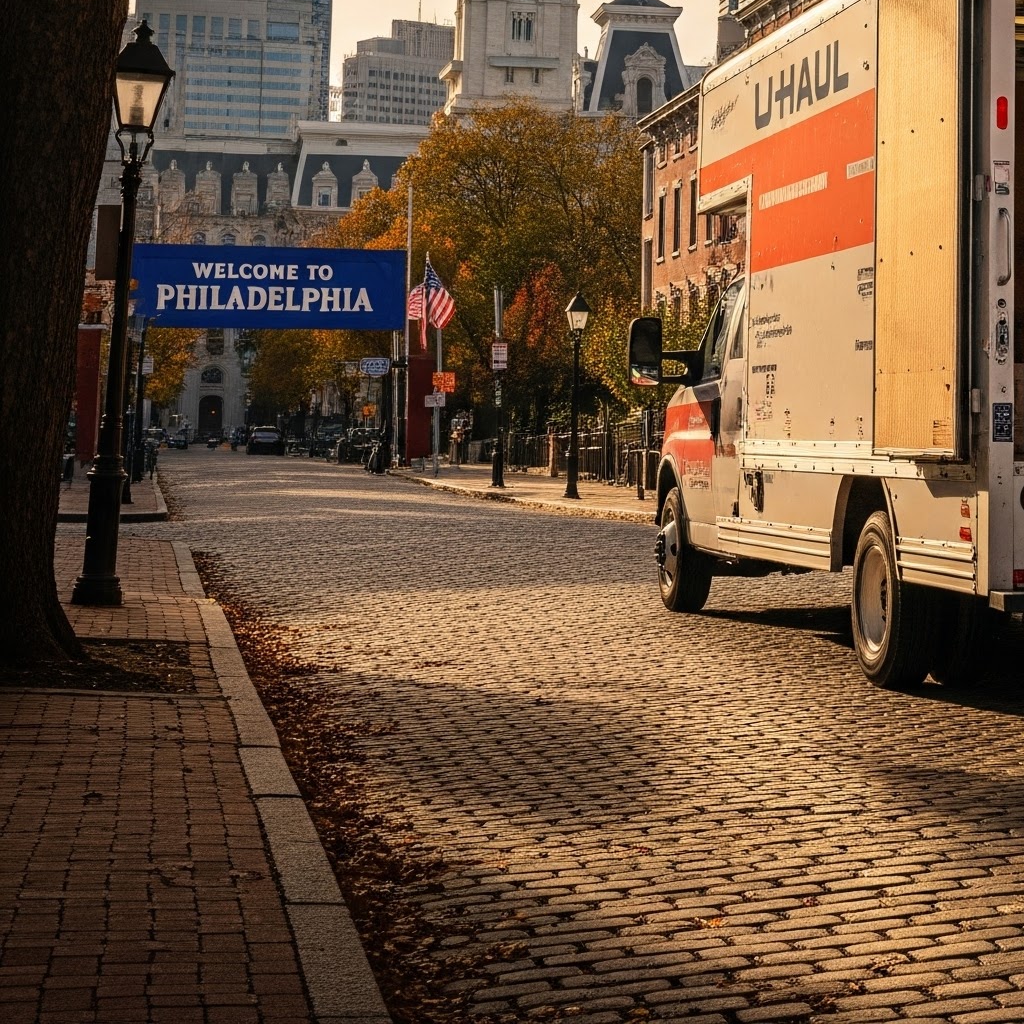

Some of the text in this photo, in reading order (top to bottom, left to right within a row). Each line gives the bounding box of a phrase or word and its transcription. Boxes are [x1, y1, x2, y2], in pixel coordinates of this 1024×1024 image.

[191, 262, 334, 281] WELCOME TO
[156, 283, 374, 312] PHILADELPHIA
